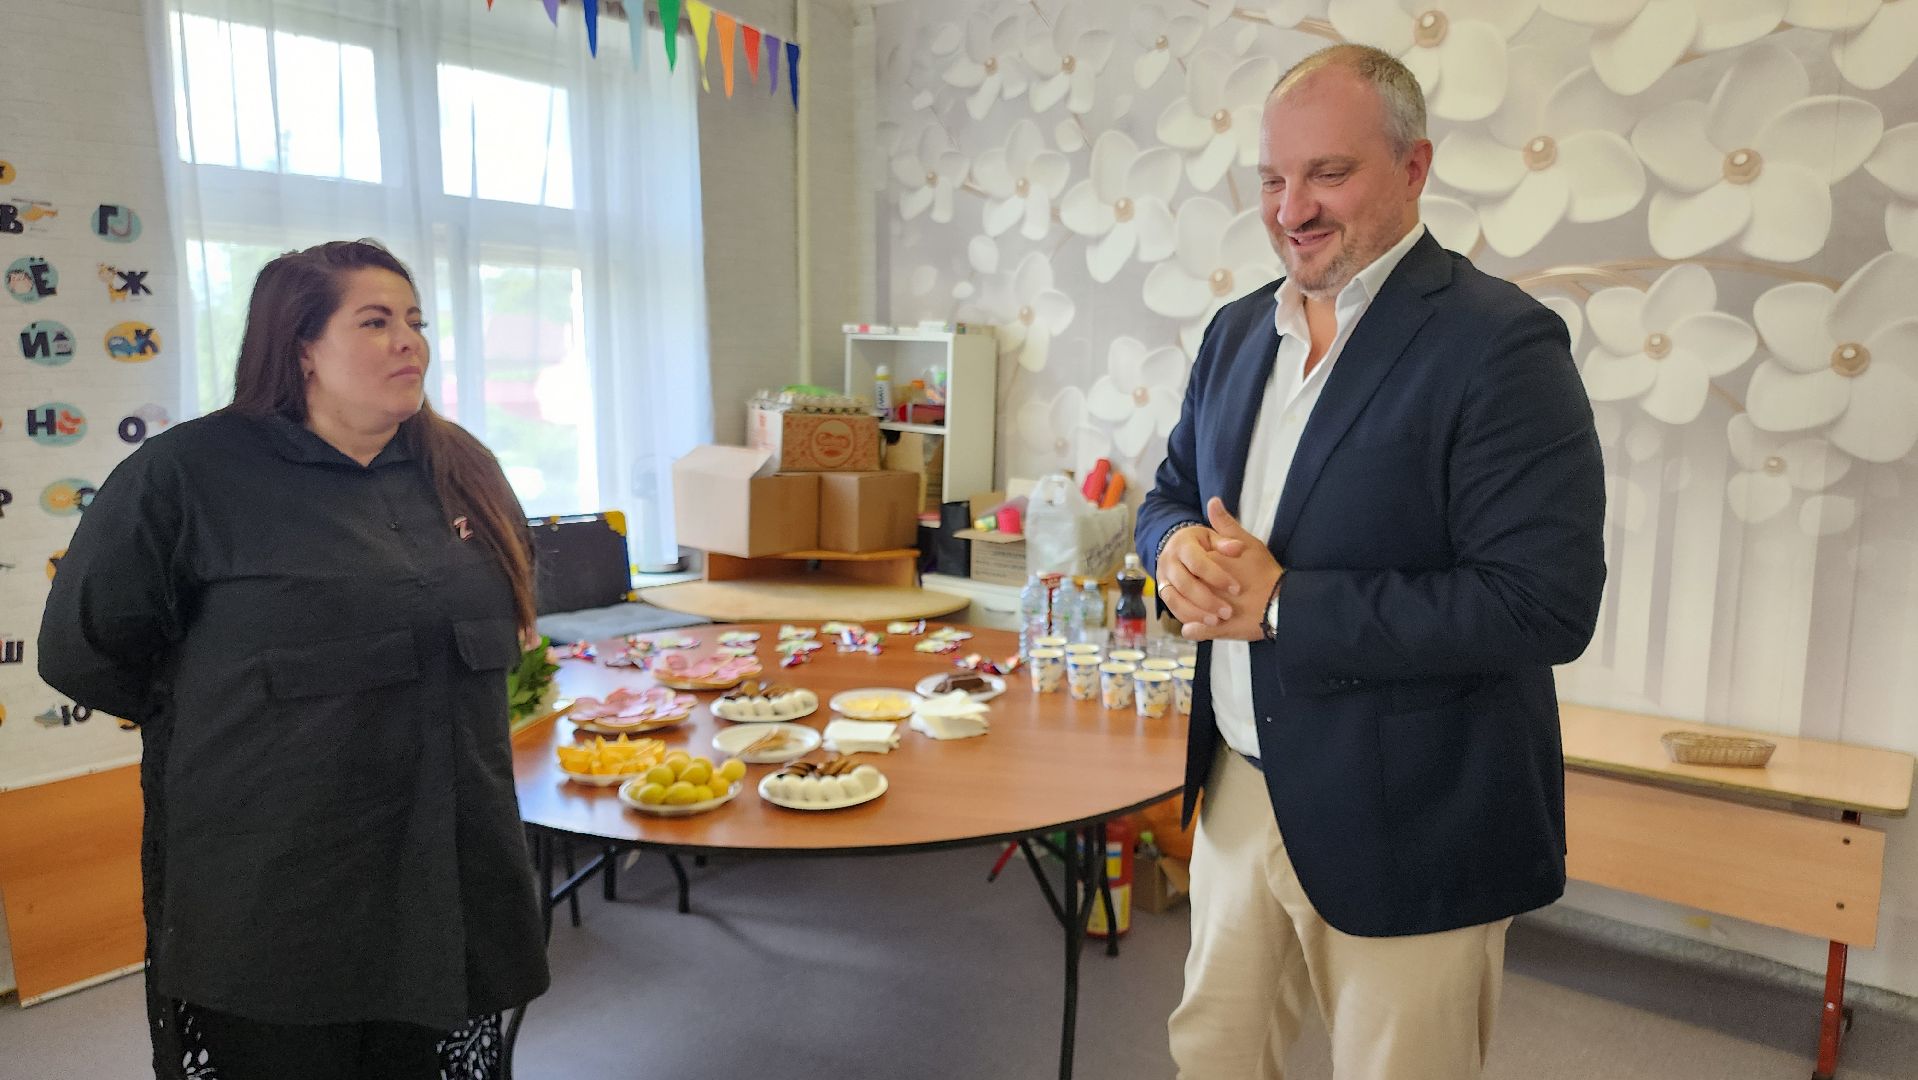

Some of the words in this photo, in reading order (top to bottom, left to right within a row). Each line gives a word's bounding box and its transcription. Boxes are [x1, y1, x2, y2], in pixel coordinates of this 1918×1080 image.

[0, 204, 24, 234] В
[98, 204, 118, 236] Г
[30, 257, 57, 298] Ё
[116, 271, 152, 295] Ж
[20, 323, 51, 359] Й
[134, 328, 159, 354] К
[27, 409, 57, 436] Н
[118, 416, 146, 443] О
[61, 704, 92, 728] Ю
